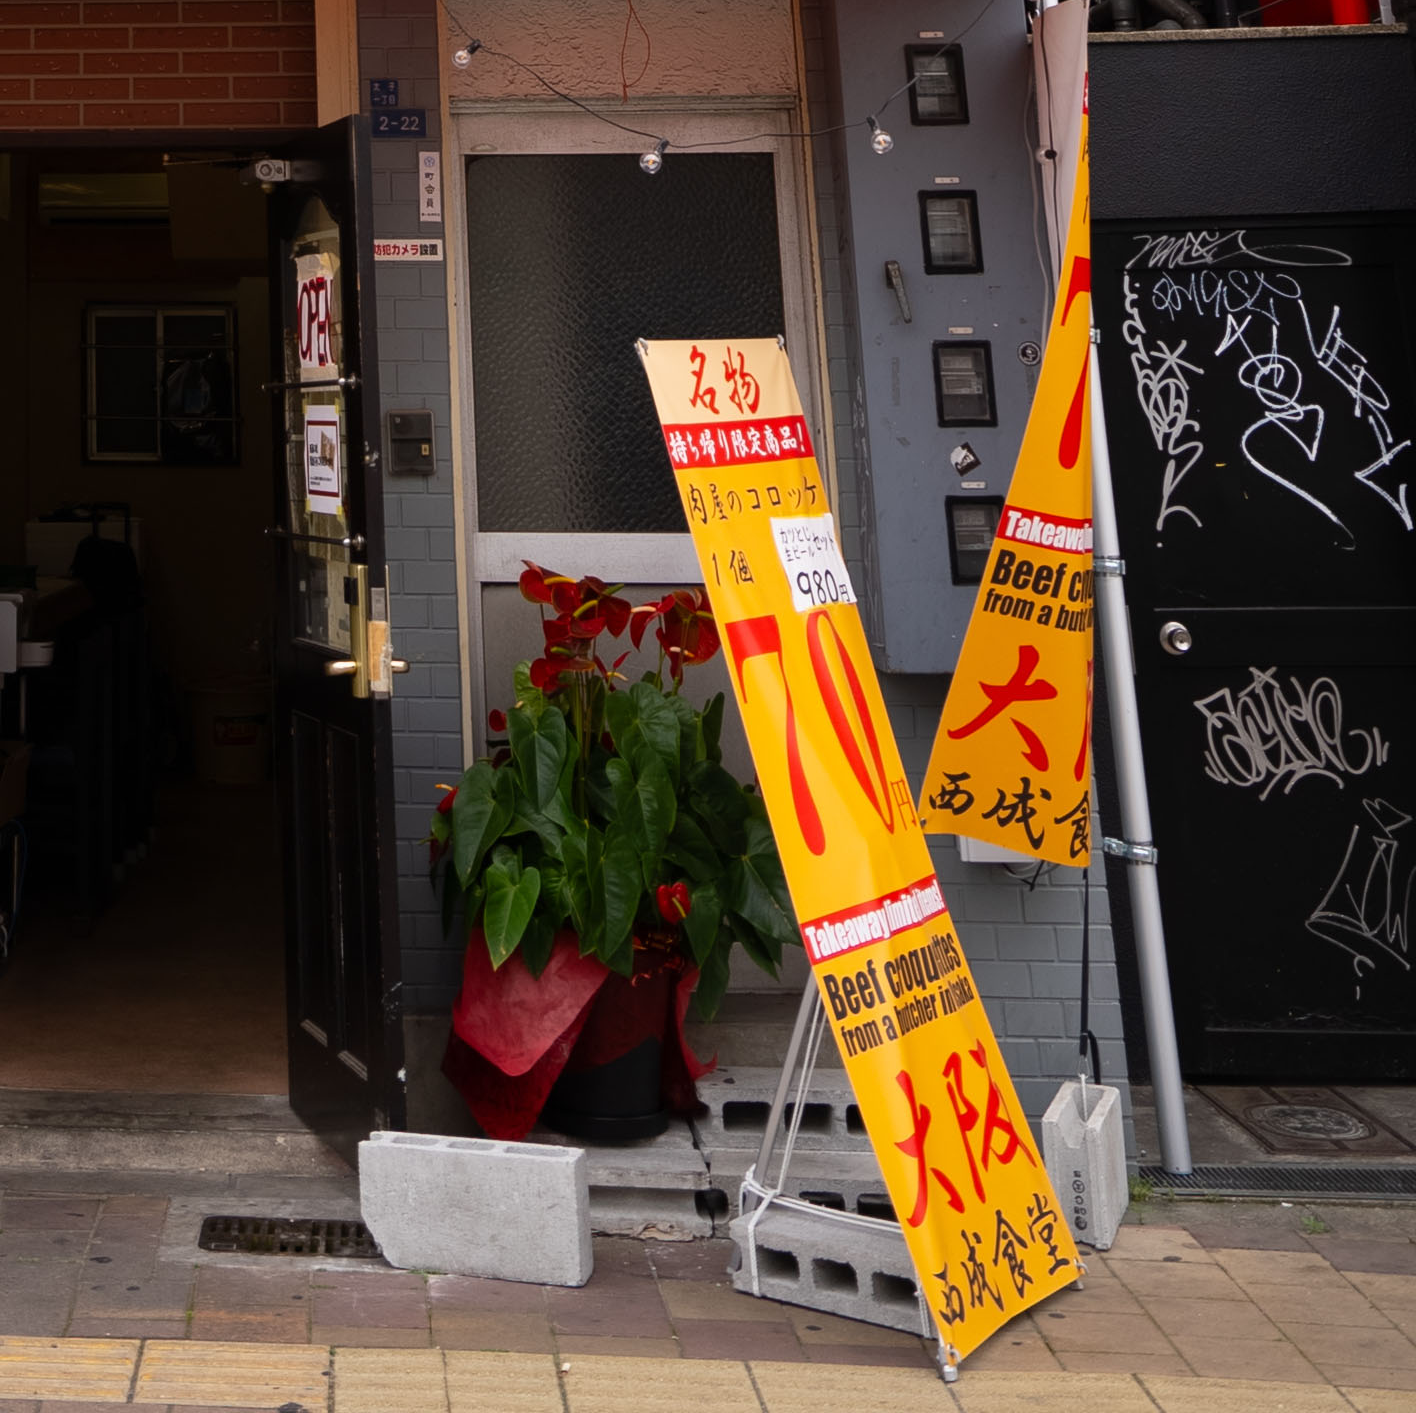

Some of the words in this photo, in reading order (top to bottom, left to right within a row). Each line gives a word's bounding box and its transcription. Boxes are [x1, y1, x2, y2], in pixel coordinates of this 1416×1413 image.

[378, 116, 420, 131] 2-22
[373, 243, 439, 256] 防犯カメラ設置
[297, 276, 335, 367] OPEN
[689, 345, 761, 415] 名物
[669, 422, 806, 465] 持ち帰り限定商品!
[687, 476, 818, 525] 肉屋のコロッケ
[711, 549, 755, 586] 1個
[785, 546, 815, 562] 生ビール
[990, 549, 1068, 599] Beef
[796, 569, 851, 607] 980円
[983, 588, 1033, 620] from
[1037, 602, 1053, 625] a
[725, 610, 918, 857] 70円
[805, 908, 891, 960] Takeaway
[823, 958, 887, 1021] Beef
[841, 1019, 884, 1058] from
[882, 1014, 898, 1041] a
[893, 994, 938, 1037] butcher
[937, 984, 957, 1016] in
[895, 1039, 1037, 1228] 大阪
[933, 1193, 1070, 1326] 西成食堂
